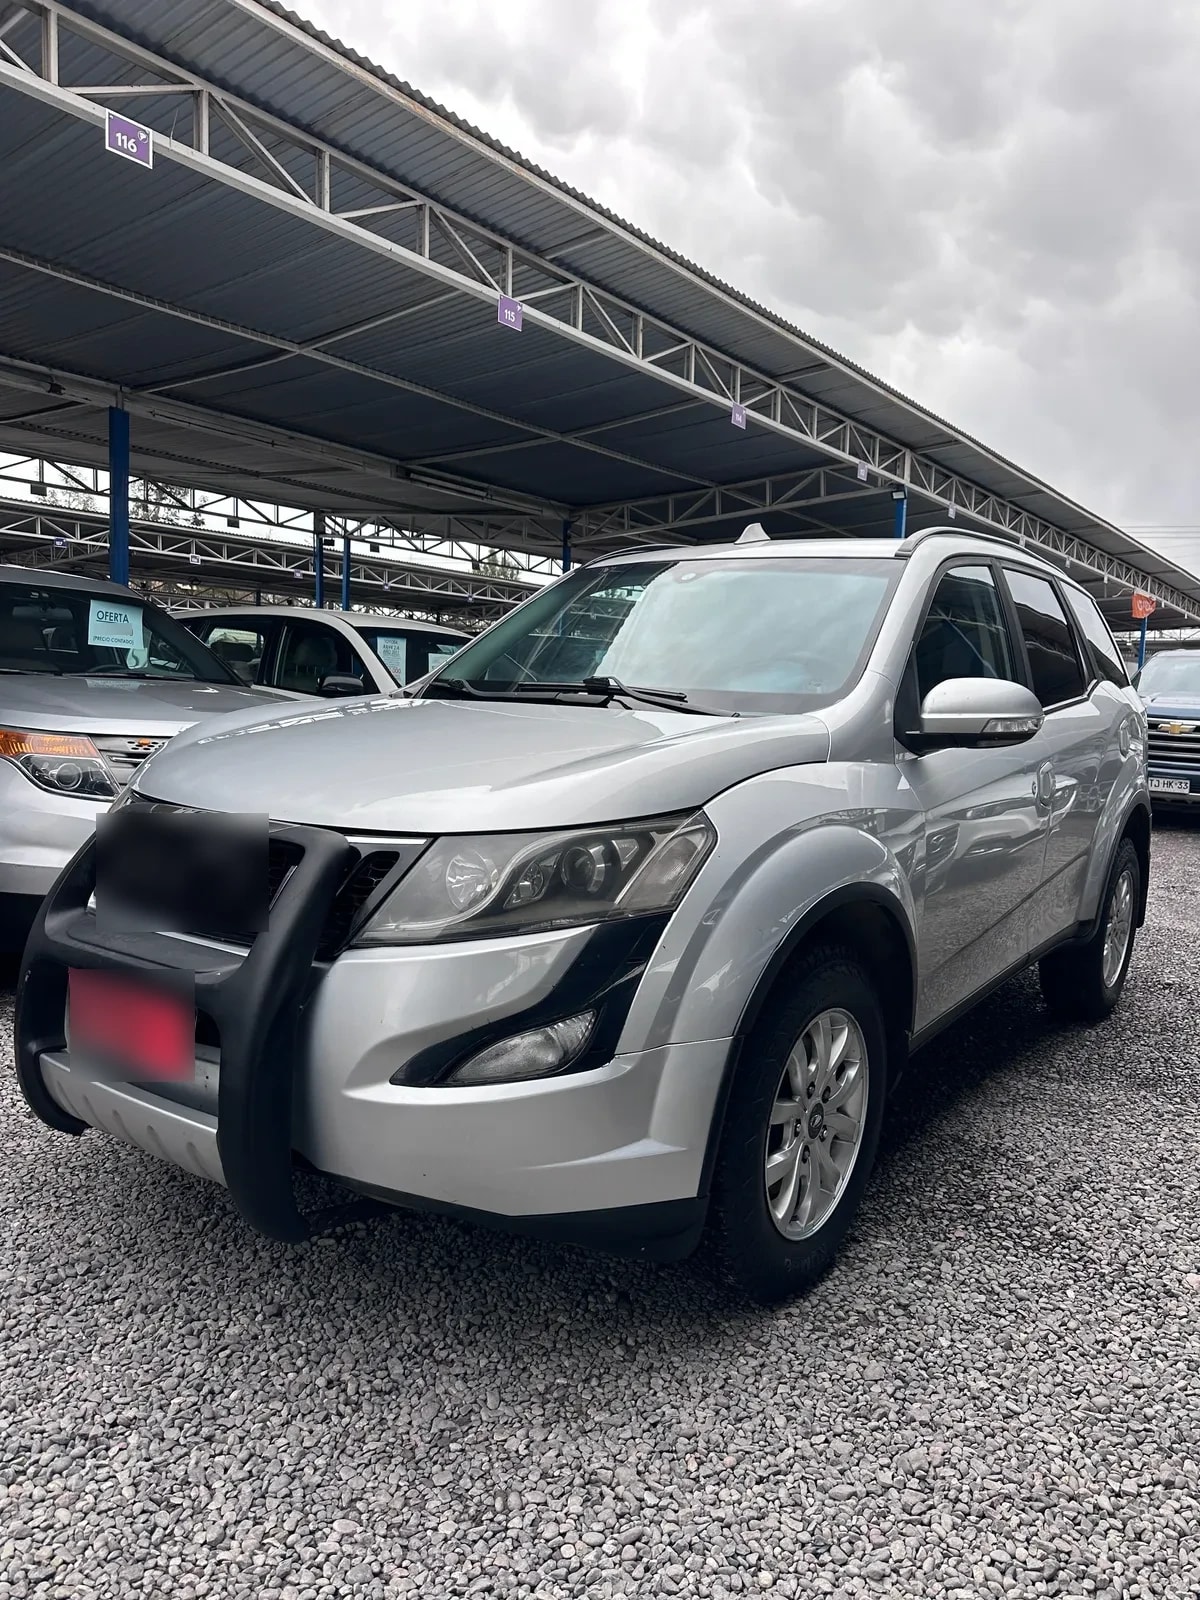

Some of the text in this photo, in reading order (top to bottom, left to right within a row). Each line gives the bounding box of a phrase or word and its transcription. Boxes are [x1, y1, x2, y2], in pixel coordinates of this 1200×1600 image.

[115, 132, 137, 153] 116
[505, 309, 516, 322] 115
[96, 610, 130, 623] OFERTA
